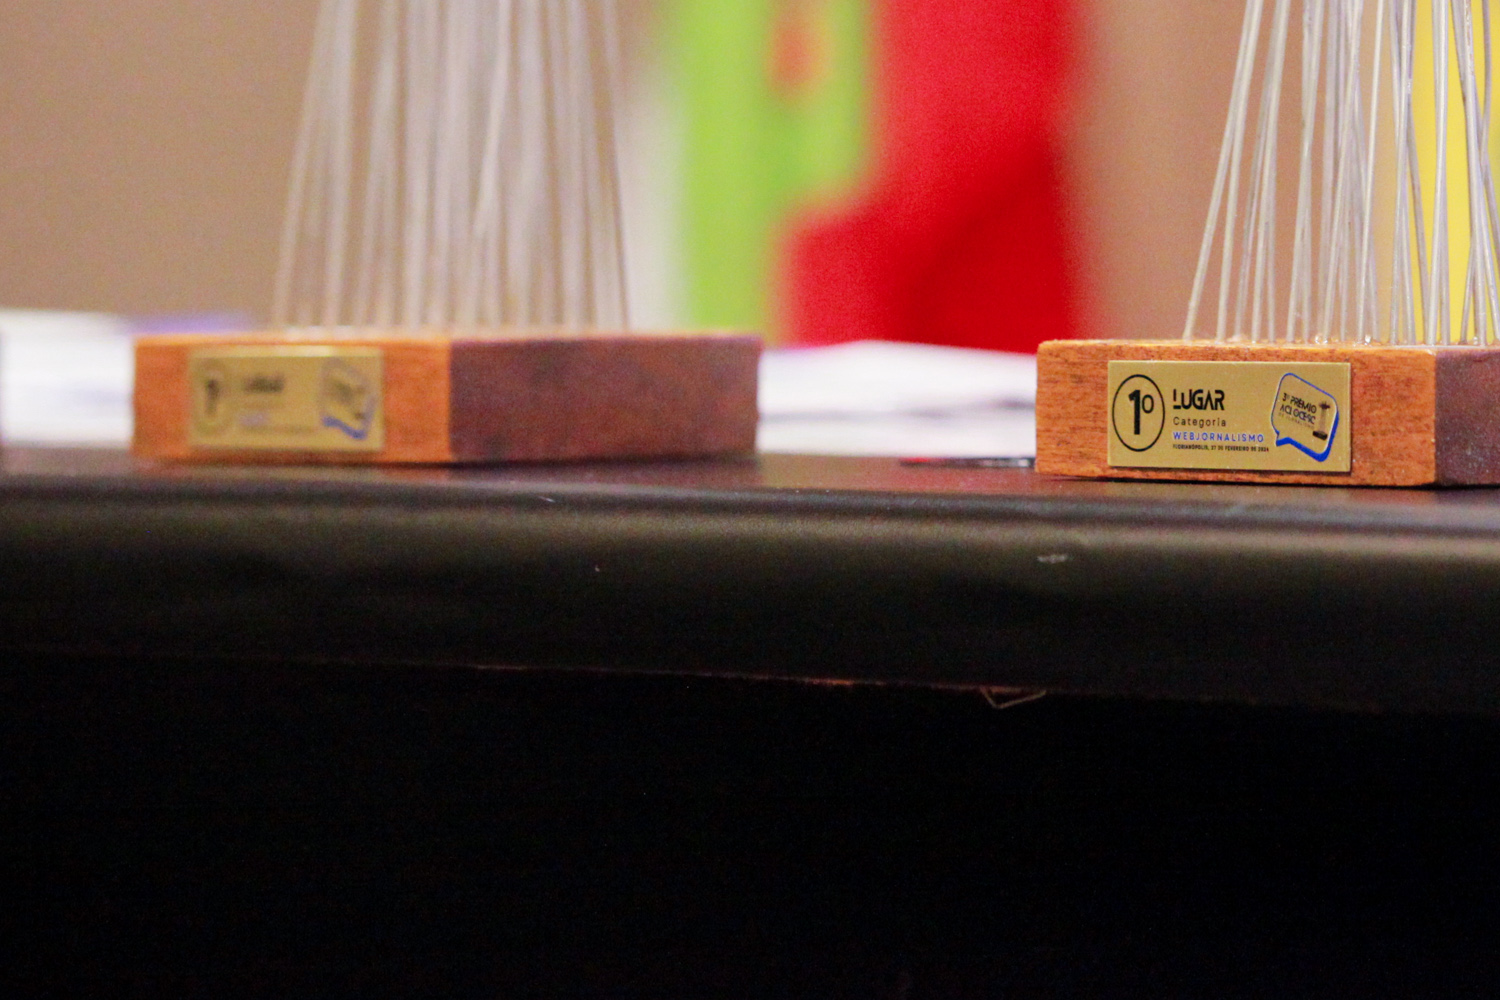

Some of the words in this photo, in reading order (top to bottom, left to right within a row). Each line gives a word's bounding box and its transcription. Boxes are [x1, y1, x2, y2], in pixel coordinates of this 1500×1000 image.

[1173, 389, 1225, 410] LUGAR
[1173, 416, 1226, 428] Categoria
[1173, 432, 1264, 442] WEBJORNALISMO
